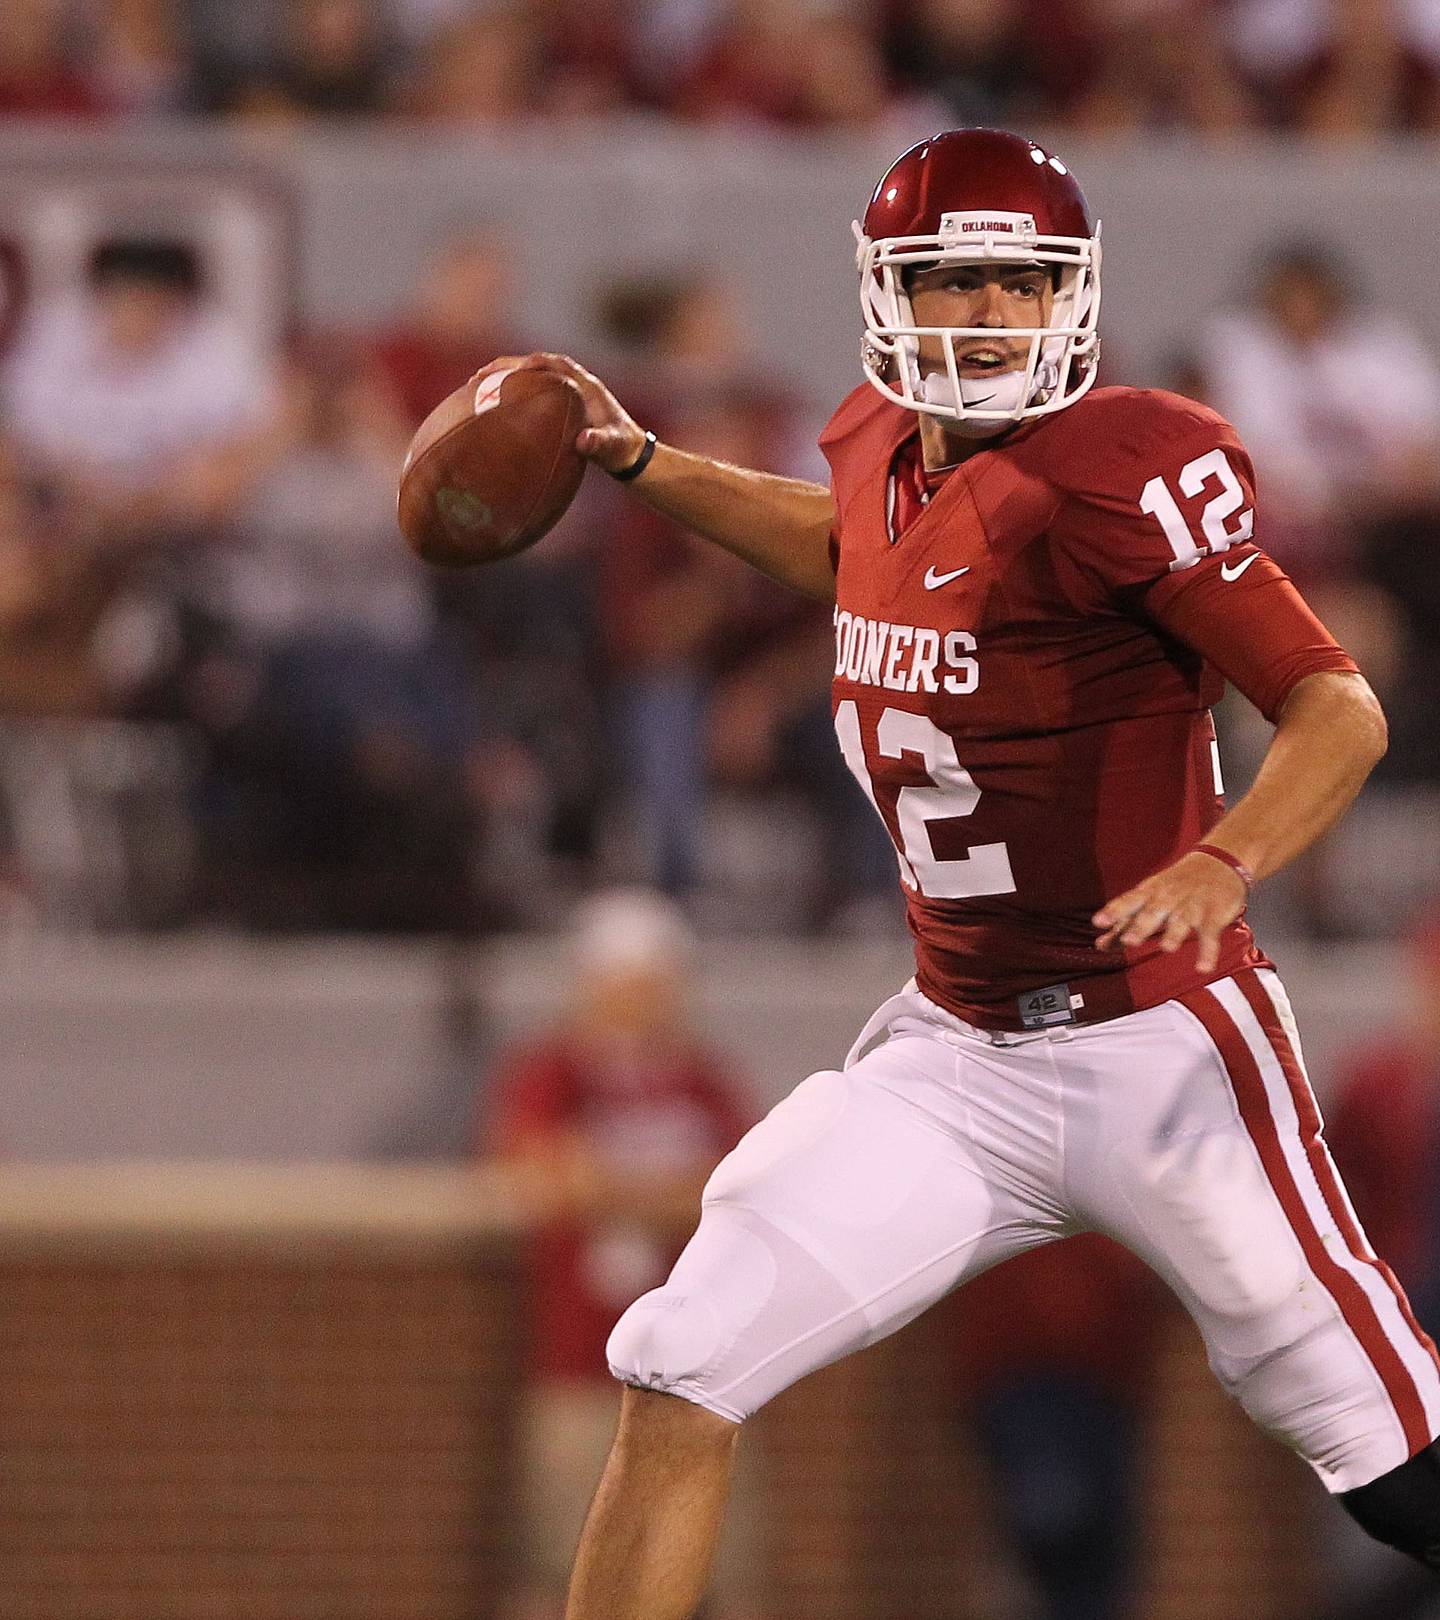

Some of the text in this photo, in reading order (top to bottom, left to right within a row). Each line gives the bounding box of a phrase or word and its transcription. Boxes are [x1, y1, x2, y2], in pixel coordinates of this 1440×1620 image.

[961, 220, 1014, 233] OKLAHOMA
[1139, 447, 1254, 572] 12
[833, 602, 980, 695] OONERS
[833, 699, 1017, 898] 12
[1028, 993, 1057, 1011] 42
